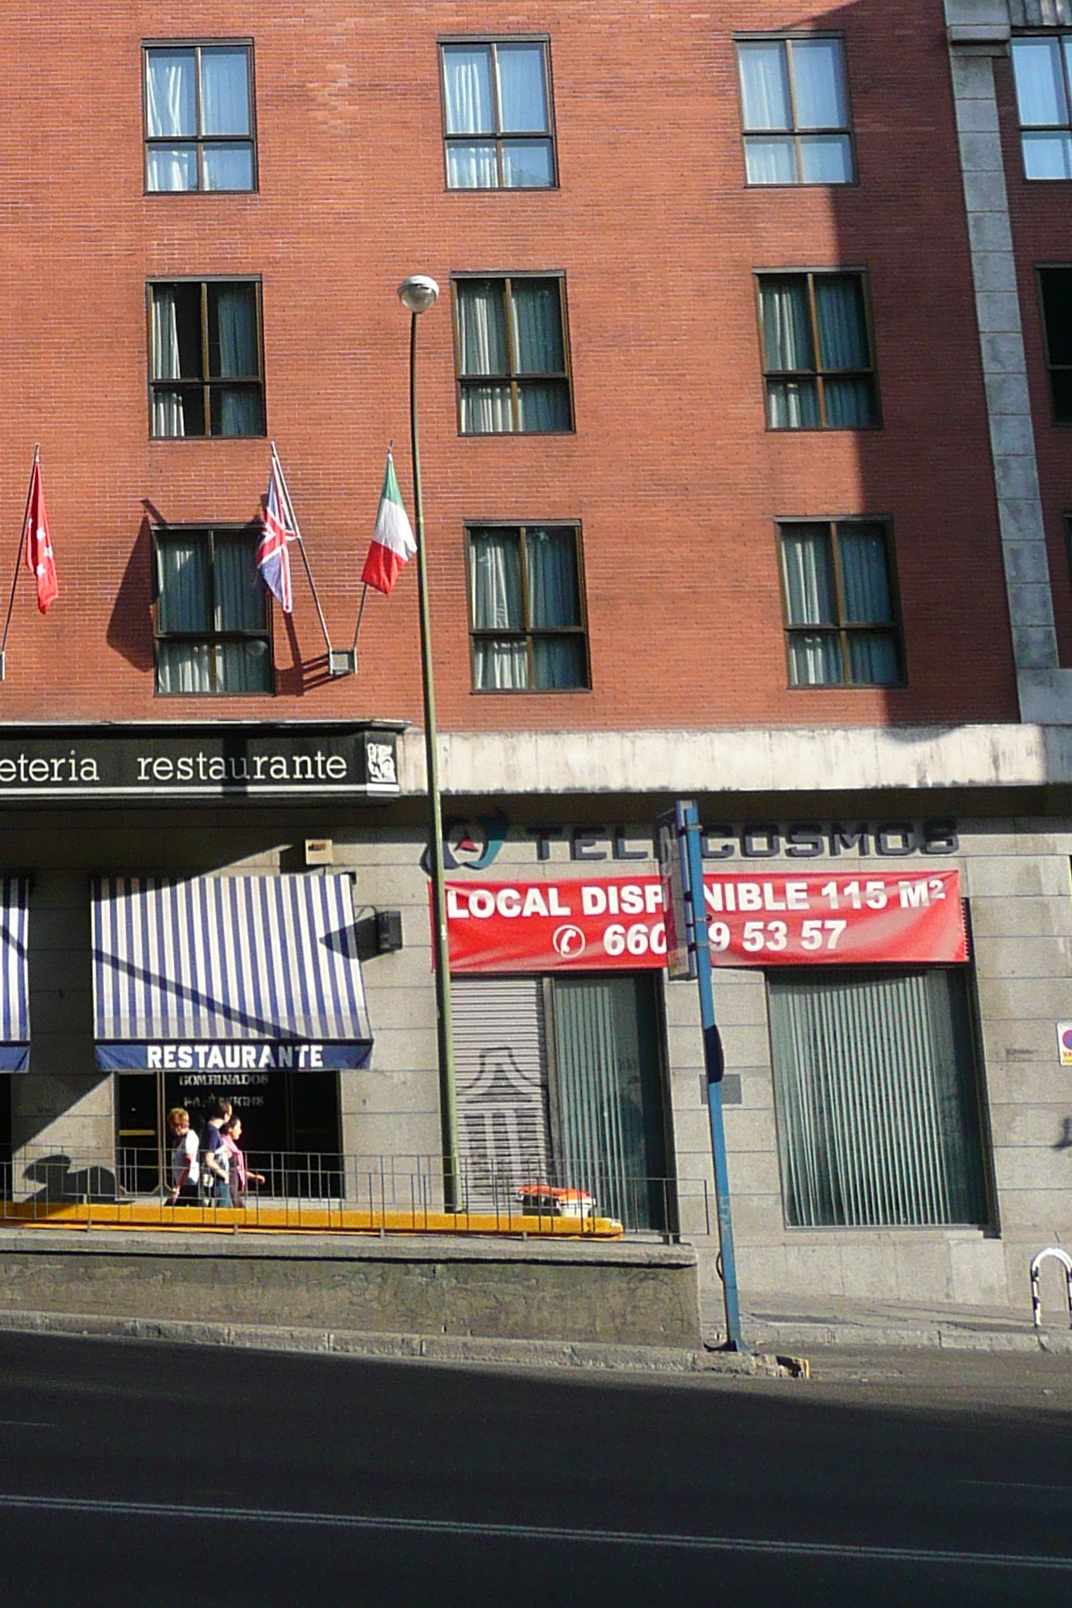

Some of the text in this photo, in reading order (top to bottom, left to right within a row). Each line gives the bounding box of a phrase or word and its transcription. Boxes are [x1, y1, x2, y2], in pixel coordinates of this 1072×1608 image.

[137, 750, 349, 781] restaurante
[528, 818, 960, 861] TELCOSMOS
[447, 885, 571, 919] LOCAL
[582, 881, 809, 916] DISPNIBLE
[821, 879, 887, 910] 115
[741, 920, 787, 952] 53
[801, 919, 847, 950] 57
[147, 1044, 324, 1069] RESTAURANTE
